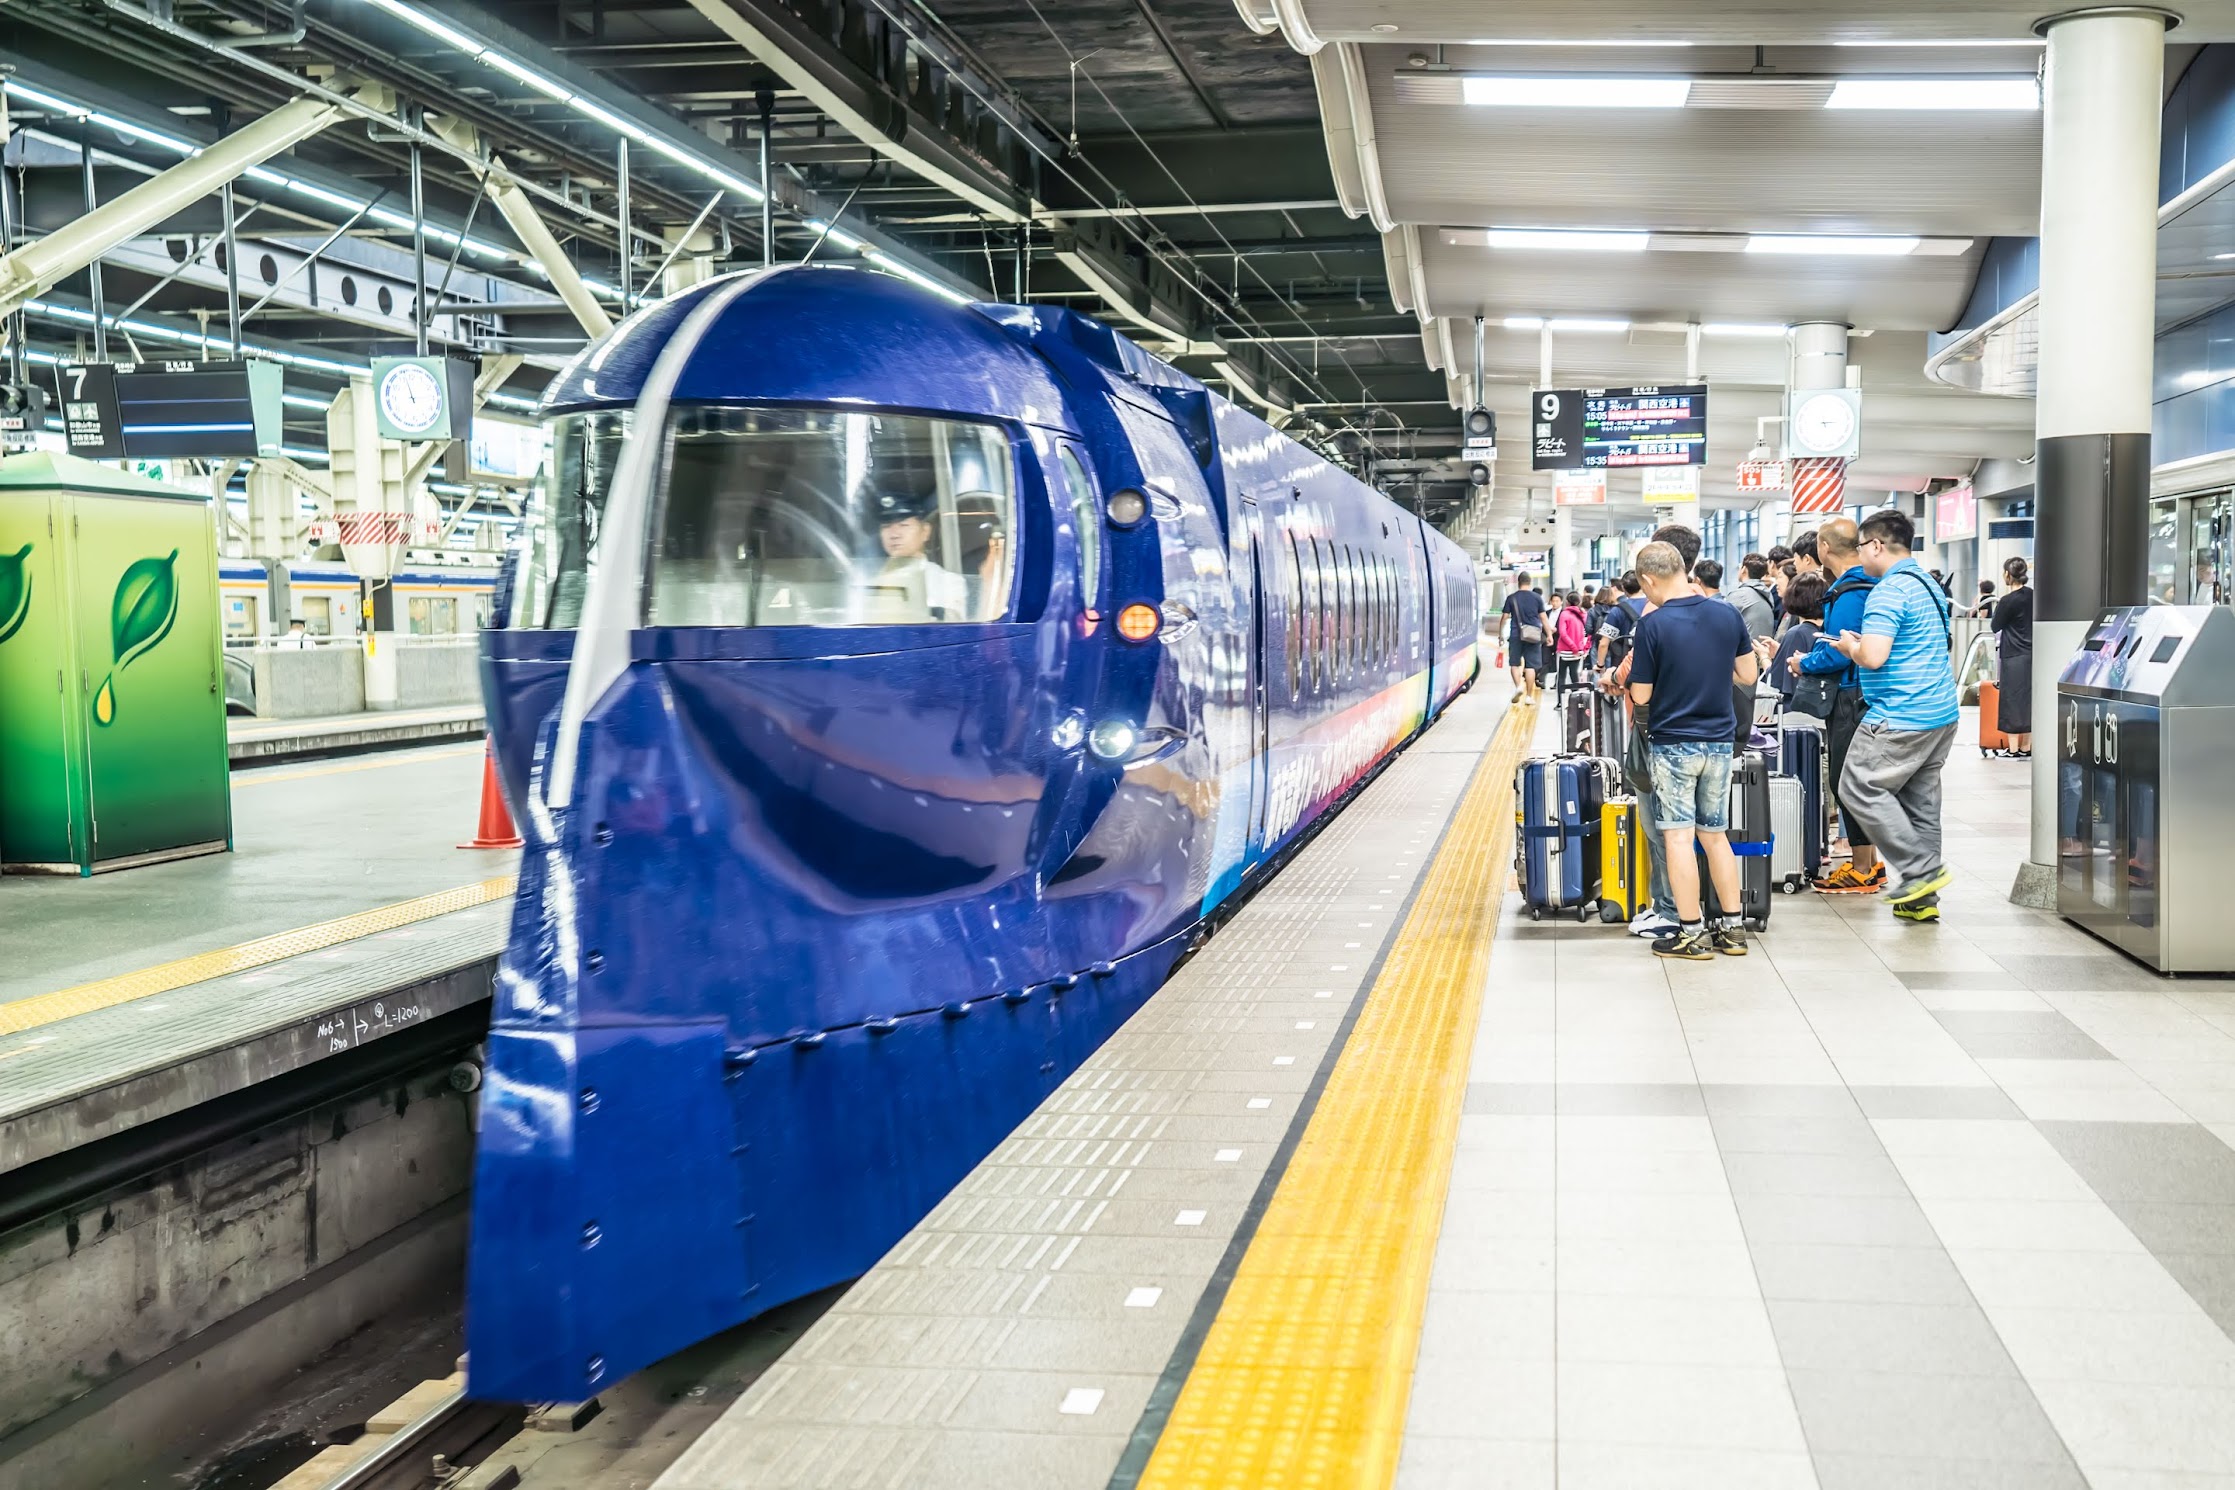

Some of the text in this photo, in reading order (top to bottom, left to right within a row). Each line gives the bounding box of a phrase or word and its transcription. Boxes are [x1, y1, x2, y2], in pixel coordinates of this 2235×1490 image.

[66, 368, 87, 400] 7
[1541, 394, 1560, 421] 9
[1585, 411, 1608, 421] 15:05
[1585, 456, 1608, 466] 15:35
